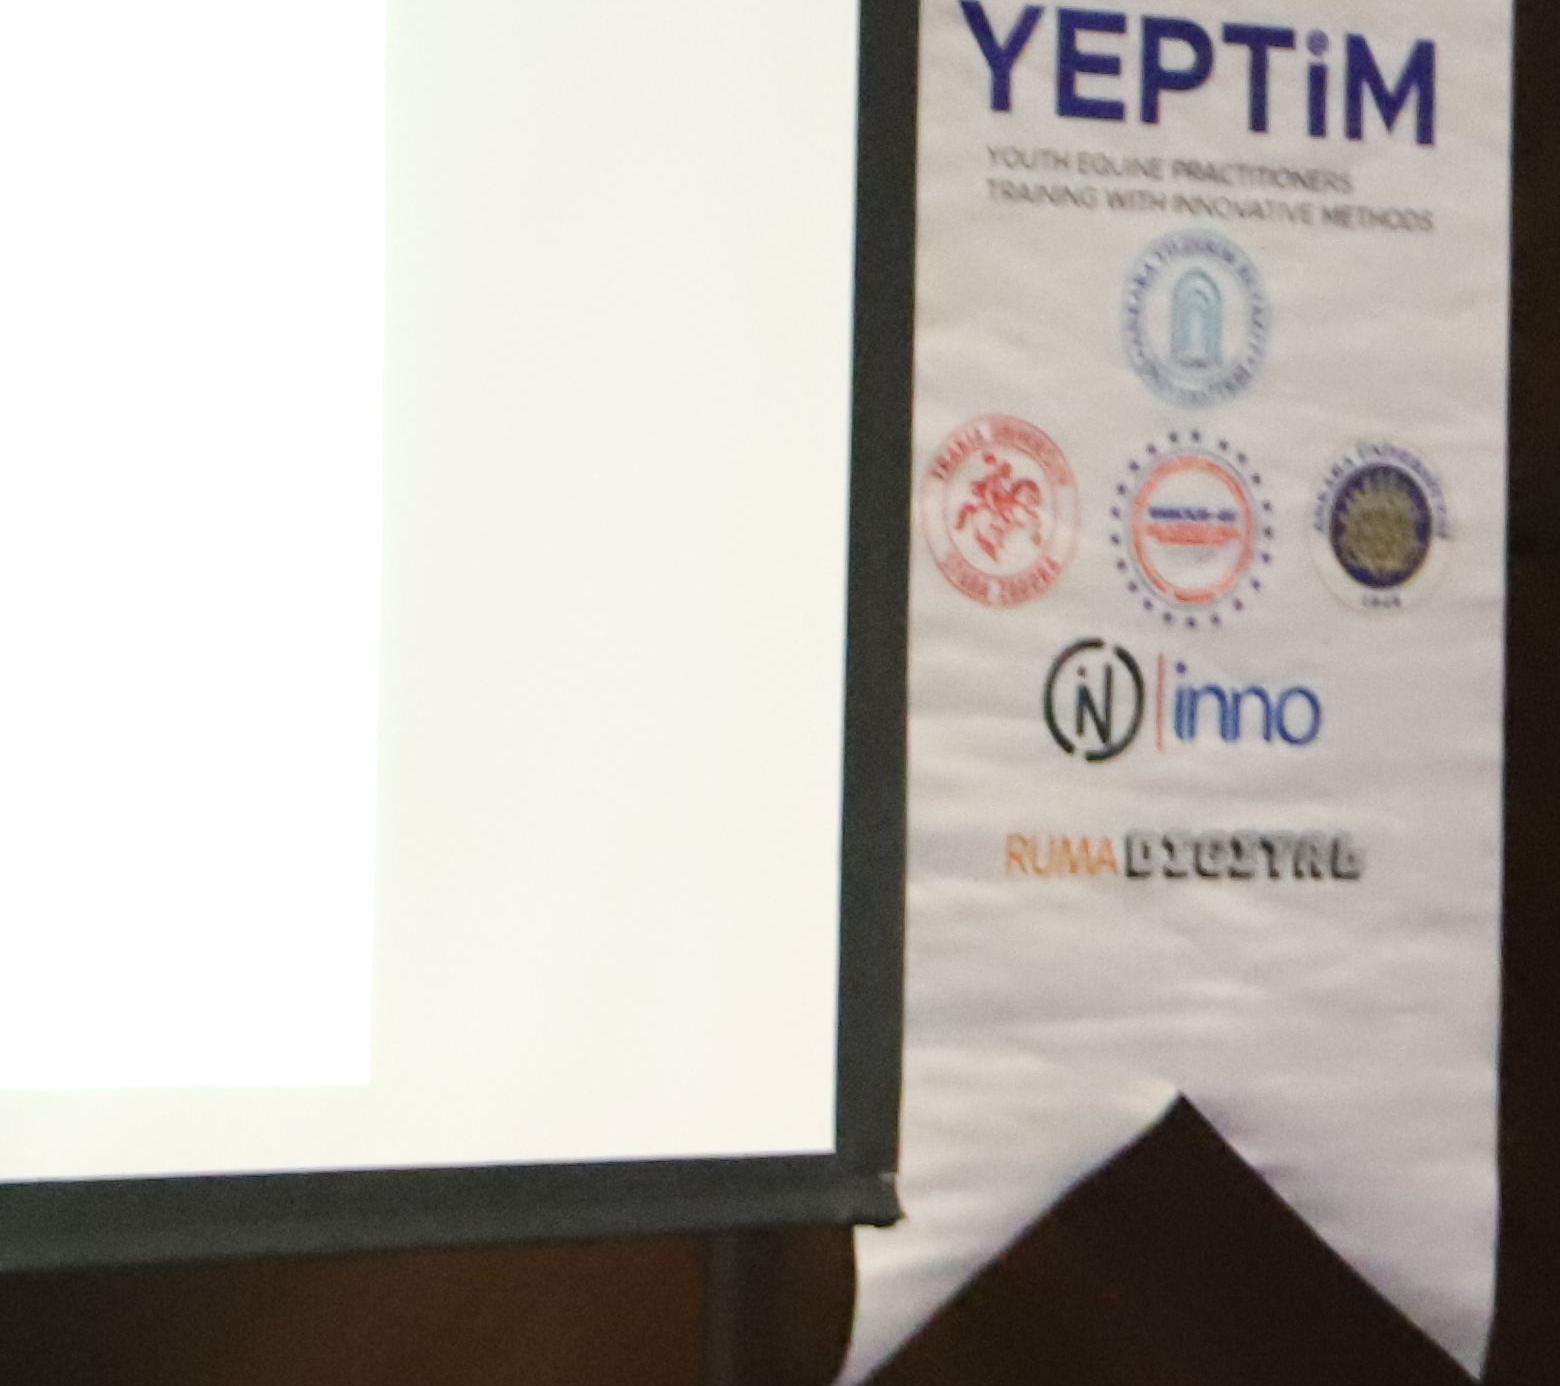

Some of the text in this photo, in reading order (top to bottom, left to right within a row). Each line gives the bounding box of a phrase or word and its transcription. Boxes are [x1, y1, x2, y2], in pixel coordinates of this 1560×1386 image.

[986, 145, 1353, 194] YOUTH EQUINE PRACTITIONERS
[986, 178, 1434, 232] TRAINING WITH INNOVATIVE METHODS
[1173, 661, 1321, 746] inno
